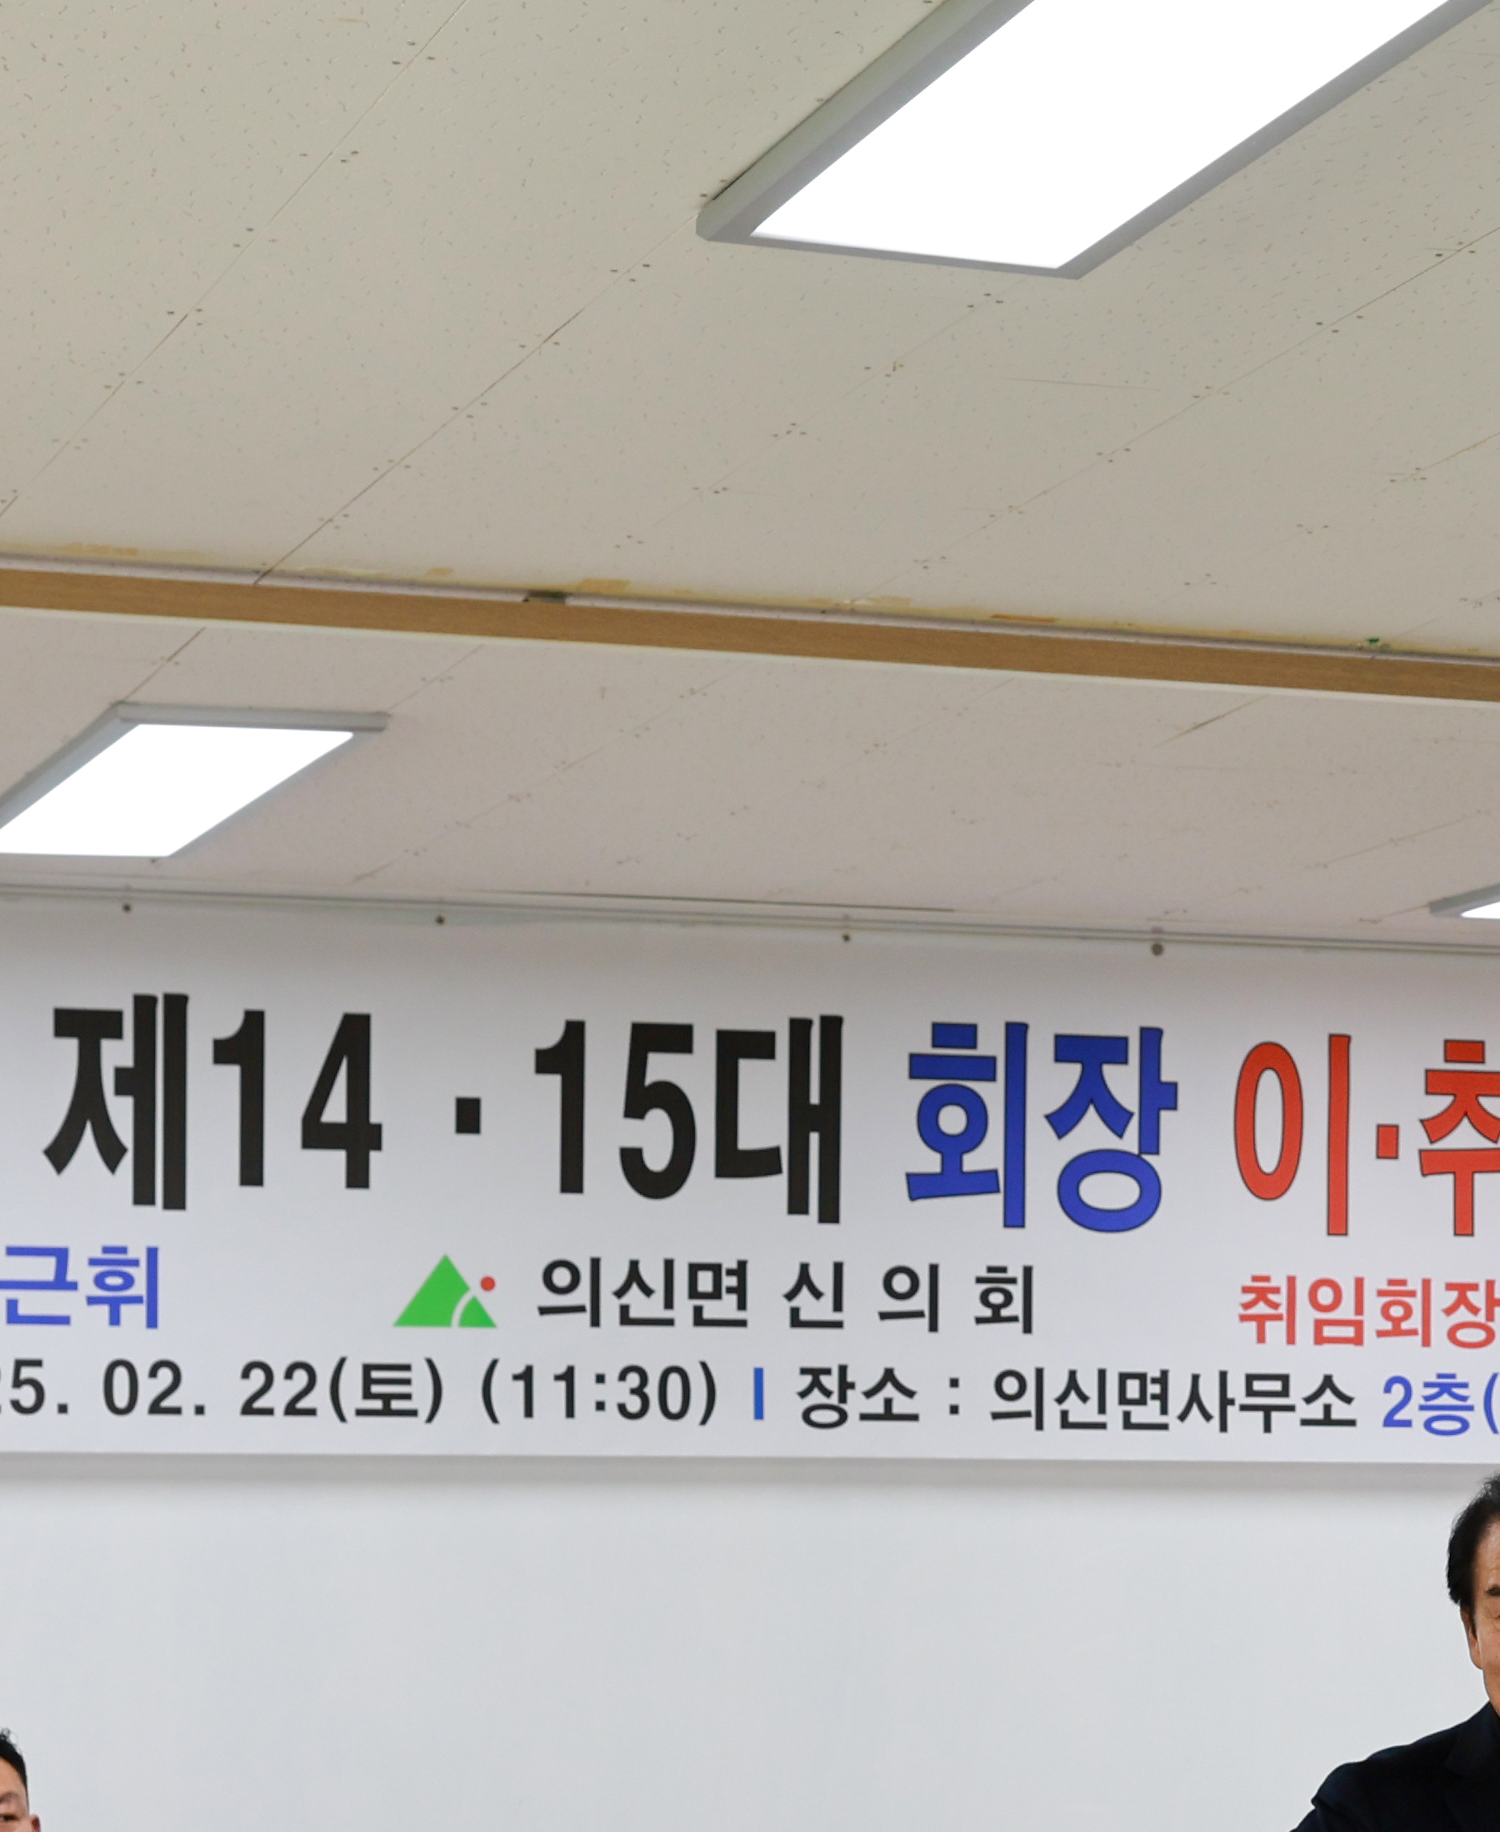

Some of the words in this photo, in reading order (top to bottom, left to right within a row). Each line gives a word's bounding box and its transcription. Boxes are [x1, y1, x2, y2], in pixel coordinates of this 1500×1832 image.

[534, 1014, 843, 1225] 15대
[905, 1021, 1179, 1233] 회장
[536, 1256, 750, 1329] 의신면
[101, 1358, 206, 1417] 02.
[238, 1355, 444, 1423] 22(토)
[481, 1358, 718, 1426] (11:30)
[795, 1362, 921, 1429] 장소
[989, 1366, 1359, 1435] 의신면사무소
